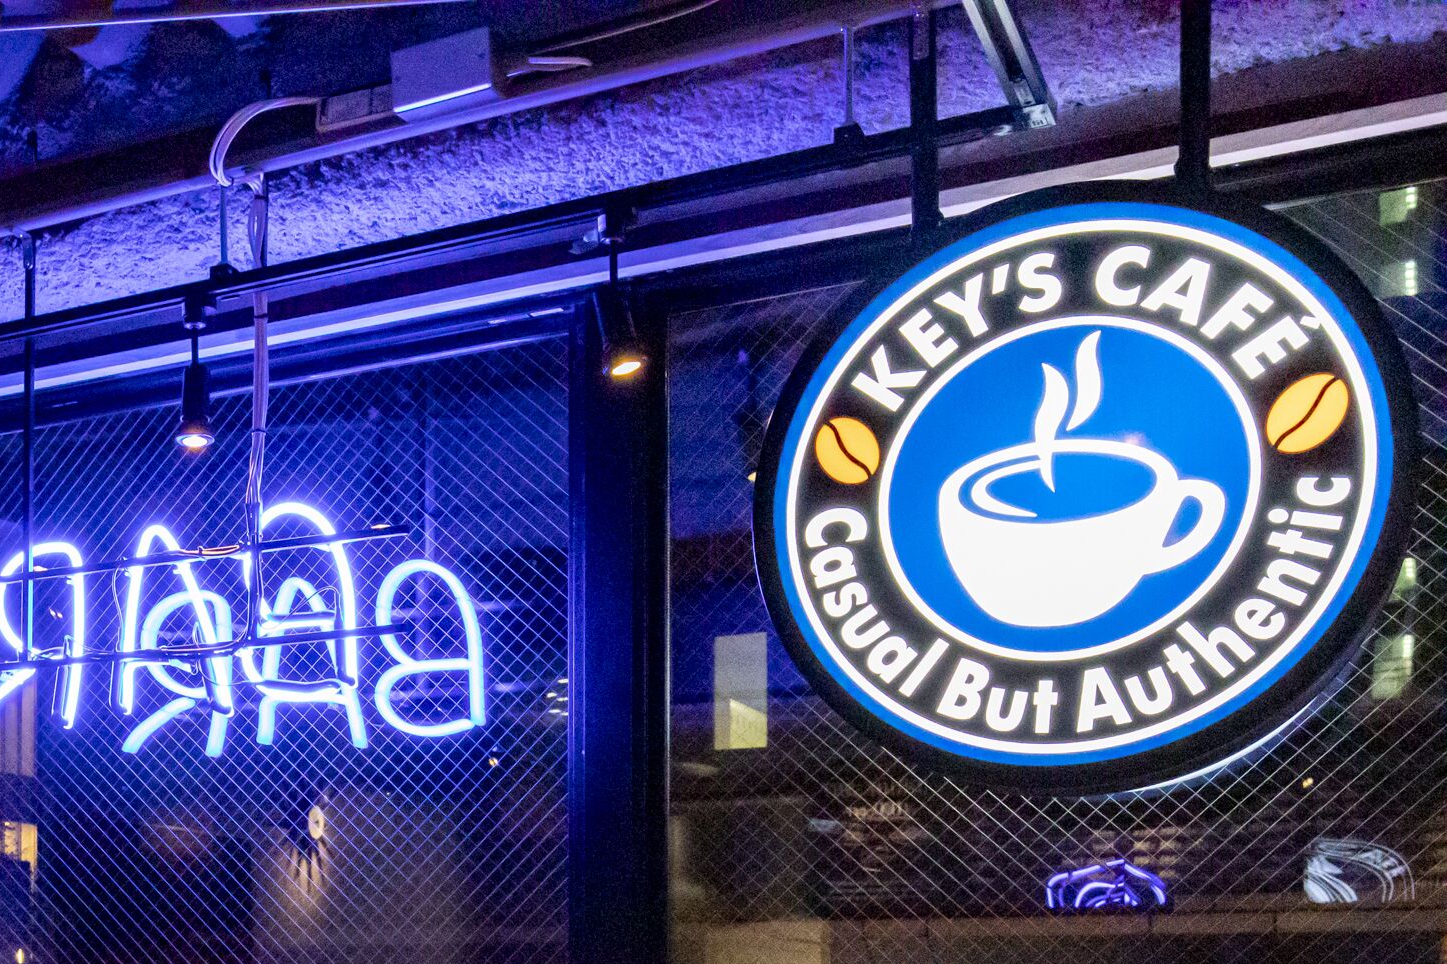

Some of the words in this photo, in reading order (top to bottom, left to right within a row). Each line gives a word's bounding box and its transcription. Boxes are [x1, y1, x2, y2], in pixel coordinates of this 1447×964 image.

[852, 253, 1064, 412] KEY'S
[806, 507, 950, 698] Casual
[937, 658, 1059, 735] But
[1077, 475, 1351, 734] Authentic
